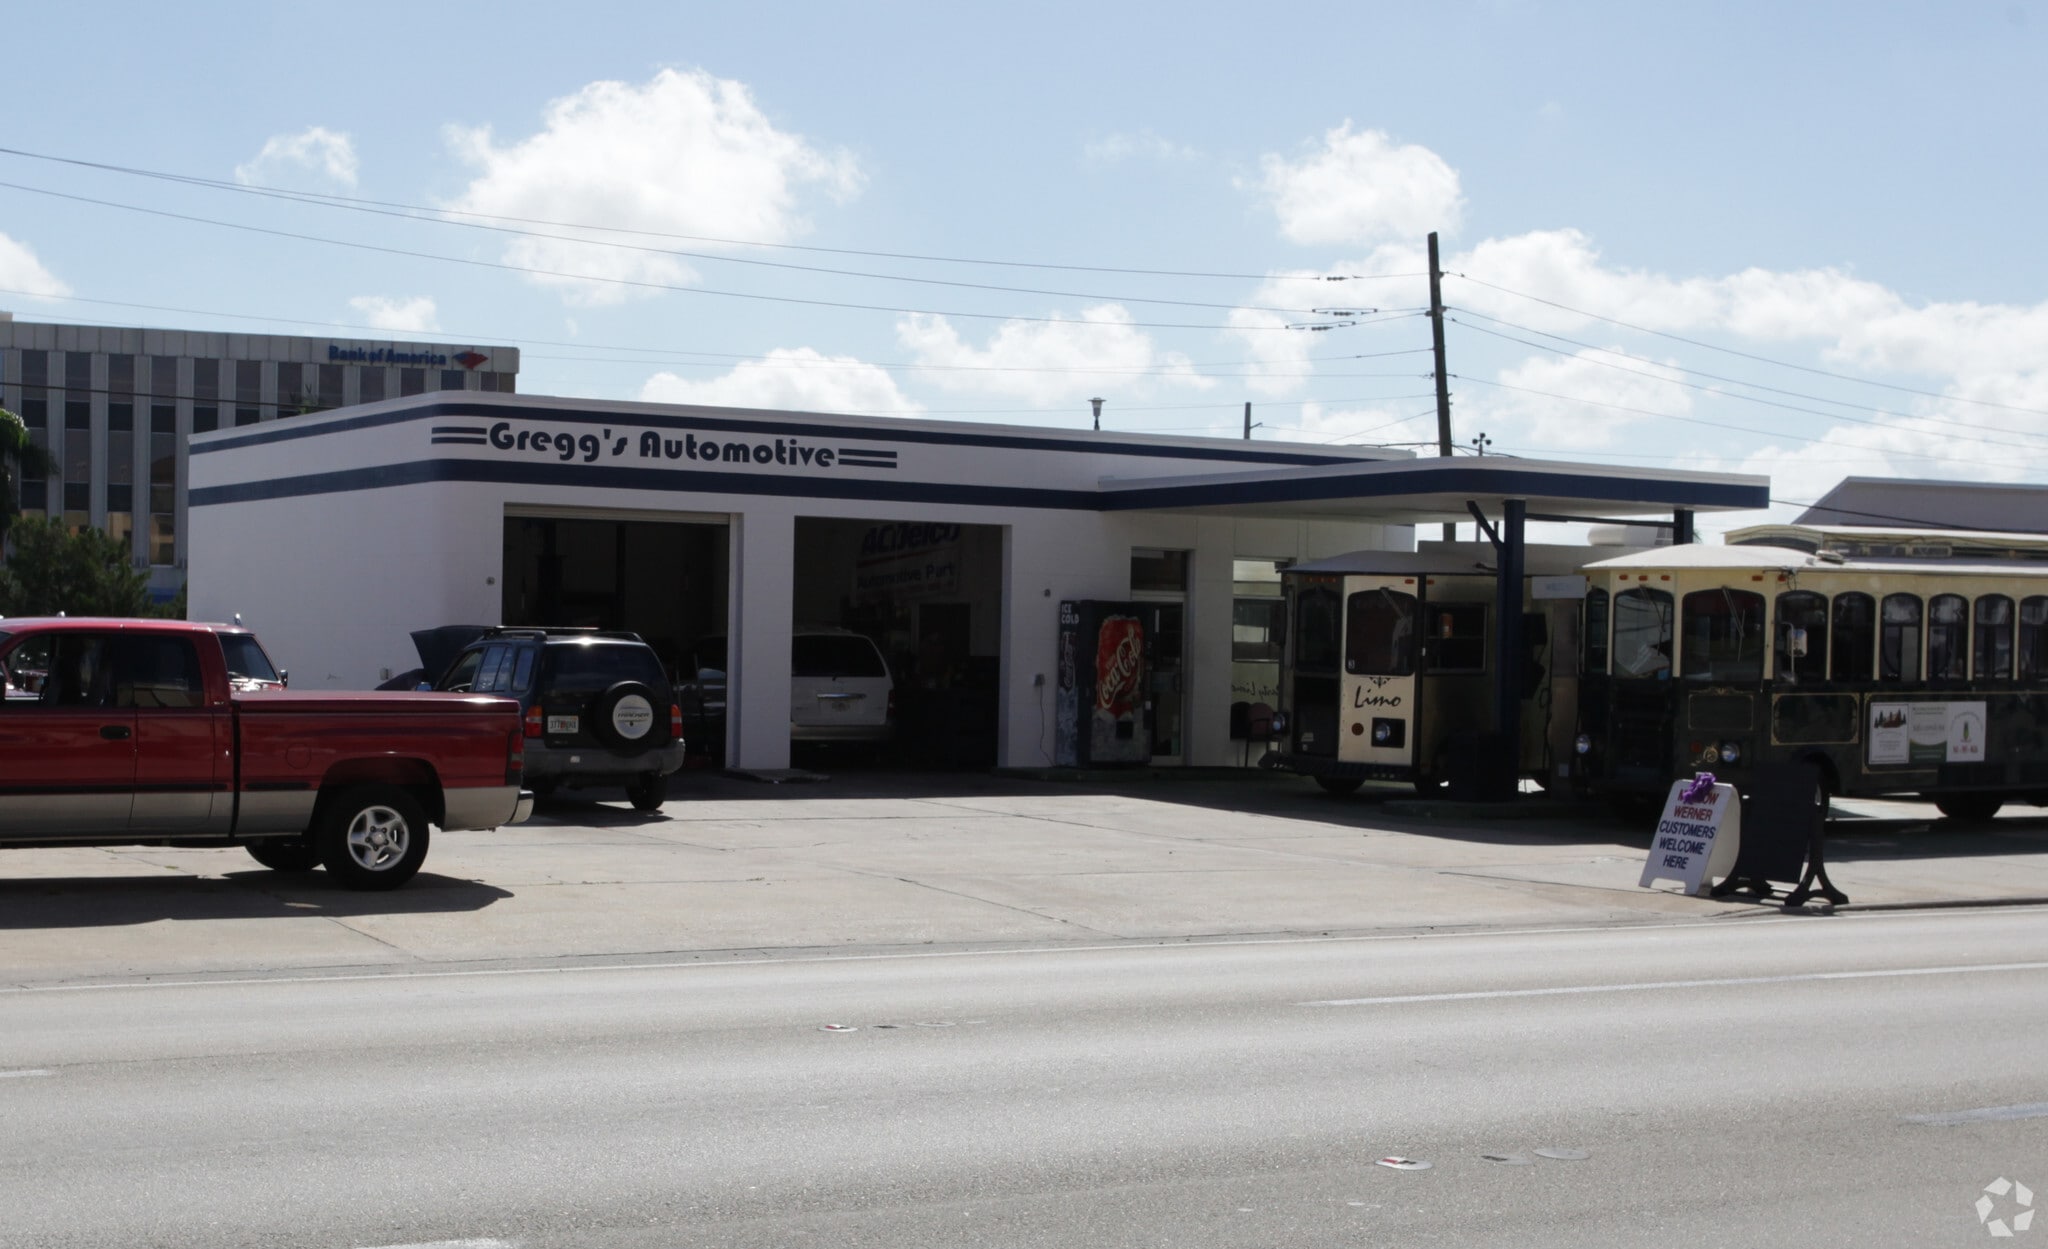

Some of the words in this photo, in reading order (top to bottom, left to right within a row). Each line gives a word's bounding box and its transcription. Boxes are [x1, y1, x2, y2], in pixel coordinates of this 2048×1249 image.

[328, 345, 367, 362] Bank
[368, 347, 384, 363] of
[385, 348, 446, 366] America
[488, 422, 628, 463] Gregg's
[639, 431, 836, 468] Automotive
[857, 568, 921, 589] Automotive
[1061, 603, 1073, 614] ICE
[1061, 613, 1080, 625] COLD
[1354, 685, 1402, 709] Limo
[1673, 805, 1714, 822] WERNER
[1659, 820, 1717, 839] CUSTOMERS
[1658, 836, 1706, 855] WELCOME
[1662, 854, 1690, 870] HERE
